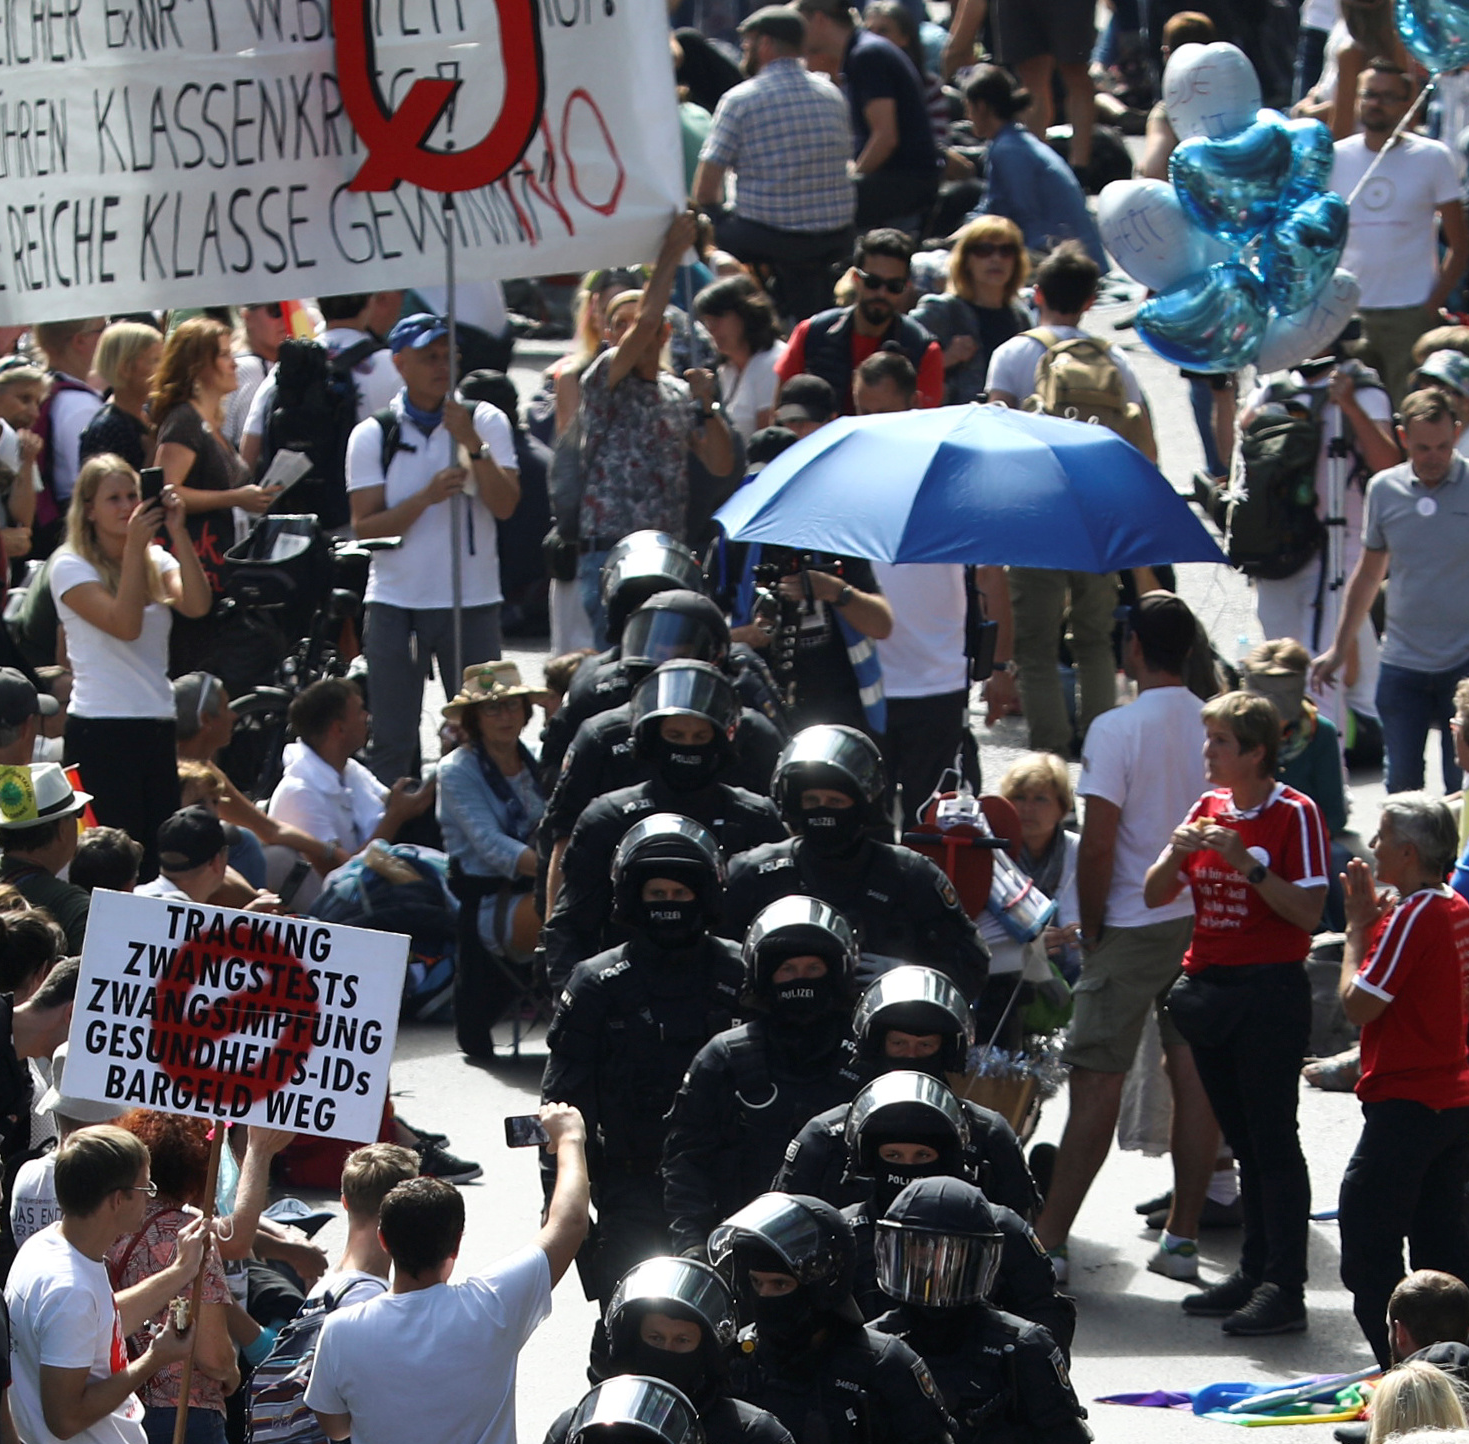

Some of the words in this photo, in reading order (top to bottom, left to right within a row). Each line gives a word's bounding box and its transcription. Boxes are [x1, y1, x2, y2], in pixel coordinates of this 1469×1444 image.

[7, 191, 120, 293] REICHE
[139, 184, 317, 282] KLASSE
[166, 904, 331, 963] TRACKING
[123, 941, 359, 1009] ZWANGSTESTS
[86, 978, 382, 1055] ZWANGSIMPFUNG
[85, 1019, 371, 1096] GESUNDHEITS-IDs
[105, 1064, 252, 1118] BARGELD
[266, 1089, 336, 1132] WEG
